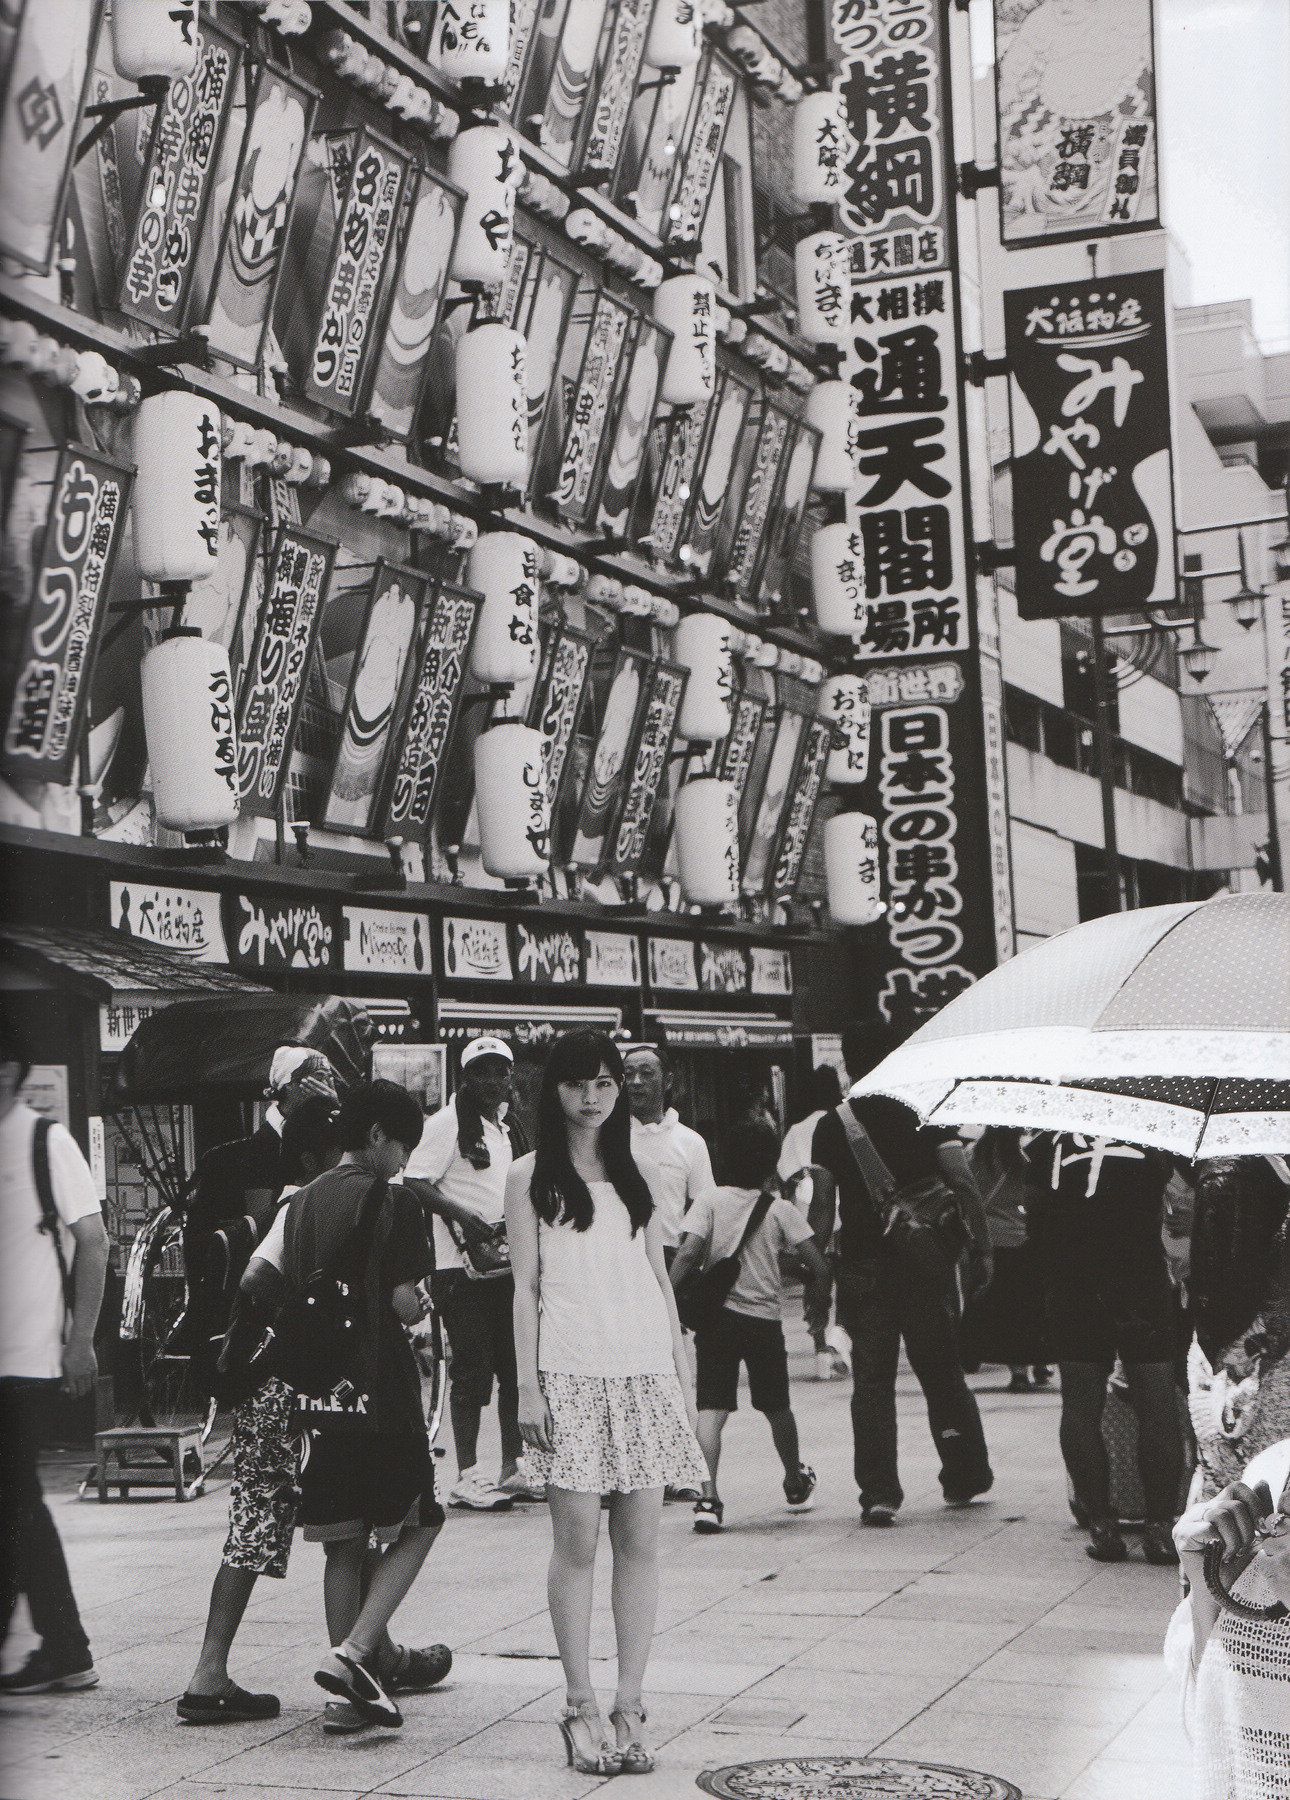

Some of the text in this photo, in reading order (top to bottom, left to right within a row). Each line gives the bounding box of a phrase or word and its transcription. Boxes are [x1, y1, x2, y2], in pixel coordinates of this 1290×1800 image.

[840, 50, 933, 227] 横綱
[1050, 123, 1096, 192] 横綱
[1025, 297, 1143, 337] 大阪物産
[850, 325, 953, 600] 通天閣
[1040, 352, 1146, 598] みやげ堂
[861, 596, 960, 652] 場所
[879, 704, 963, 966] 日本一の串かつ
[139, 892, 206, 944] 大阪物産
[238, 895, 324, 968] みやげ堂
